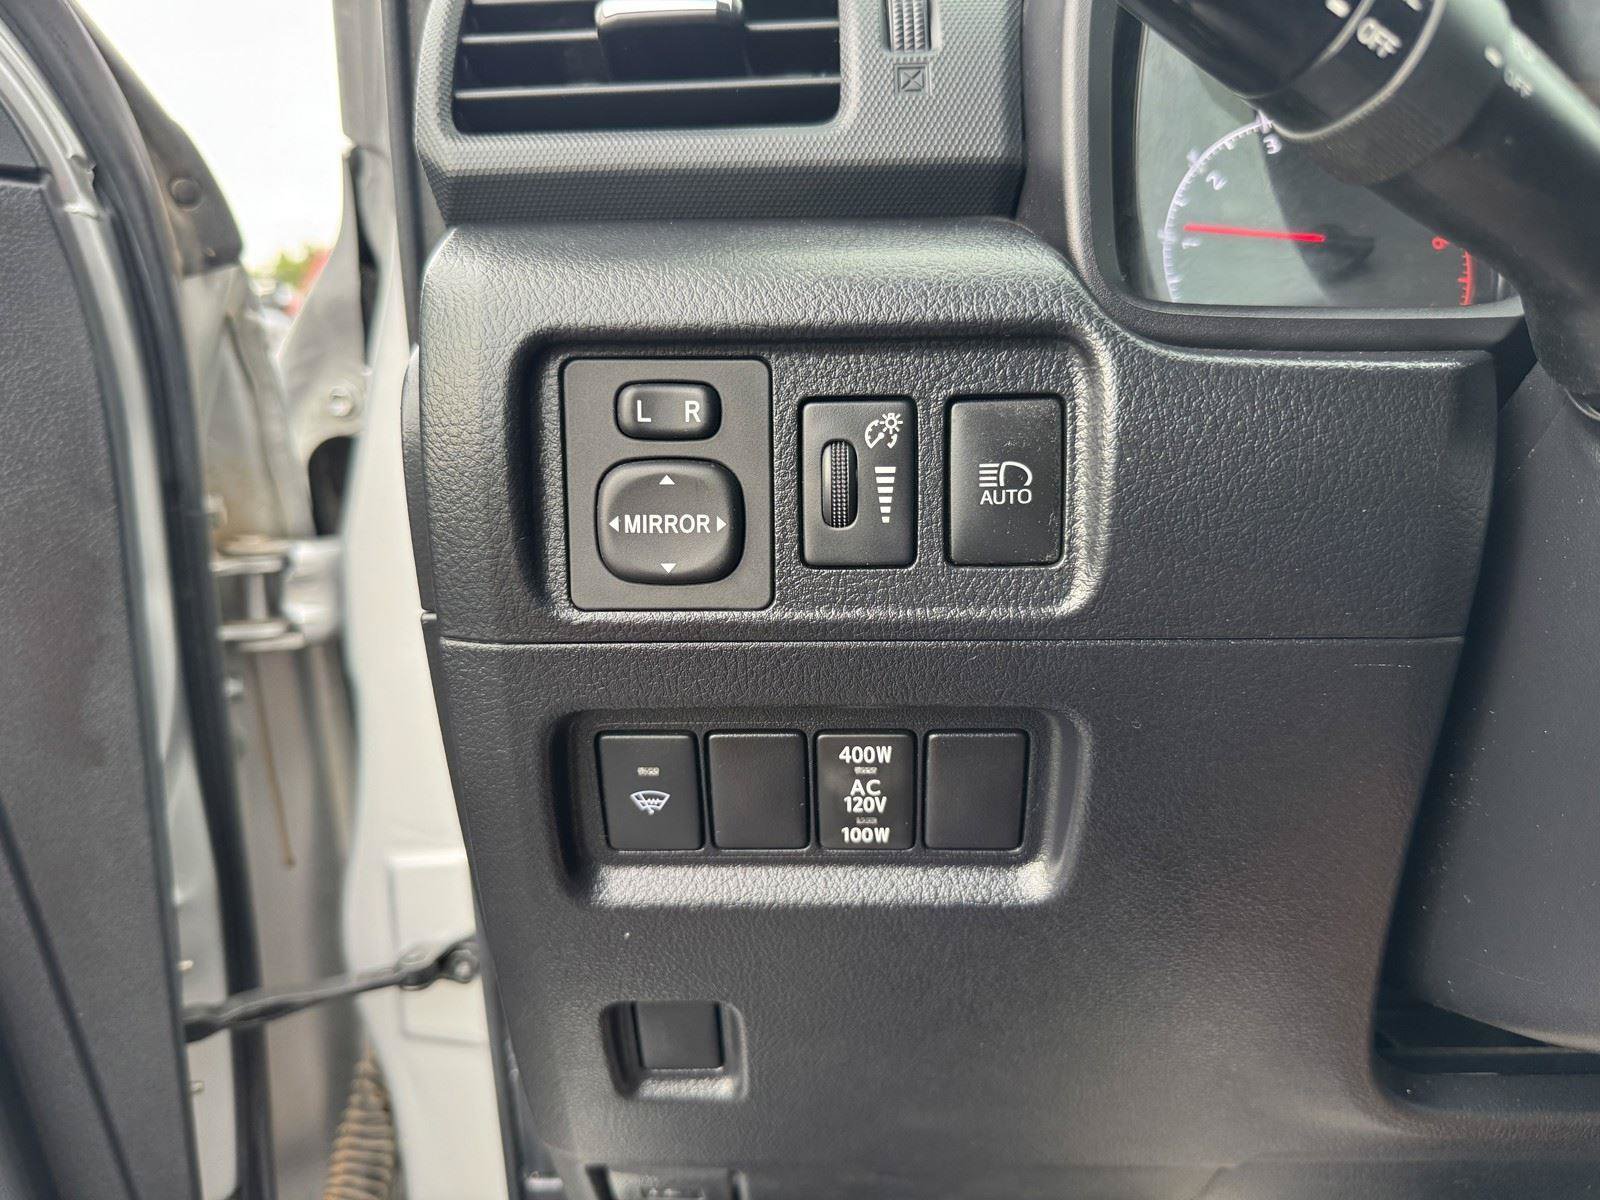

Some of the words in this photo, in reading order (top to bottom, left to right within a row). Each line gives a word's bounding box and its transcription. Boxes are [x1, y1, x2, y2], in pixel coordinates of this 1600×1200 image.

[1263, 134, 1282, 154] 3
[1206, 170, 1228, 190] 2
[636, 399, 652, 422] L
[685, 400, 701, 423] R
[979, 488, 1032, 505] AUTO
[624, 513, 711, 534] MIRROR
[838, 745, 893, 764] 400W
[850, 779, 881, 796] AC
[843, 796, 887, 813] 120V
[841, 826, 891, 843] 100W
